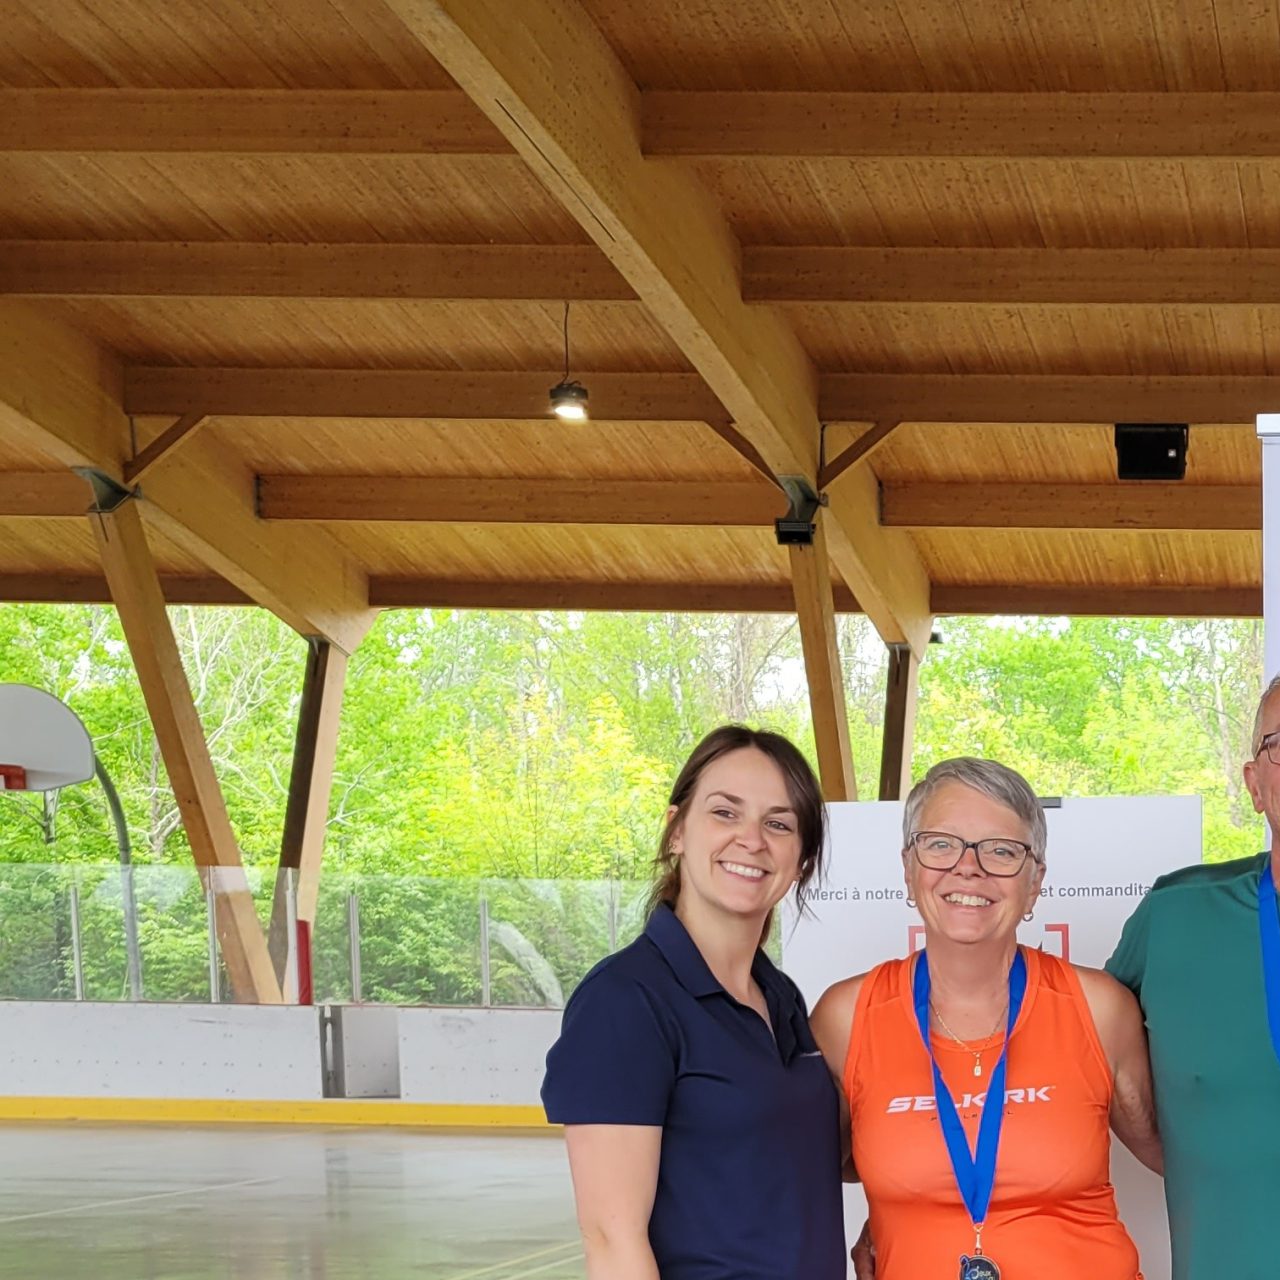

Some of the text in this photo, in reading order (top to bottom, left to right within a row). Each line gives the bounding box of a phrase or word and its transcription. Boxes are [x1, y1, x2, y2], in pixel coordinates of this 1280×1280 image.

[807, 887, 904, 901] Merci à notre
[1040, 885, 1053, 897] et
